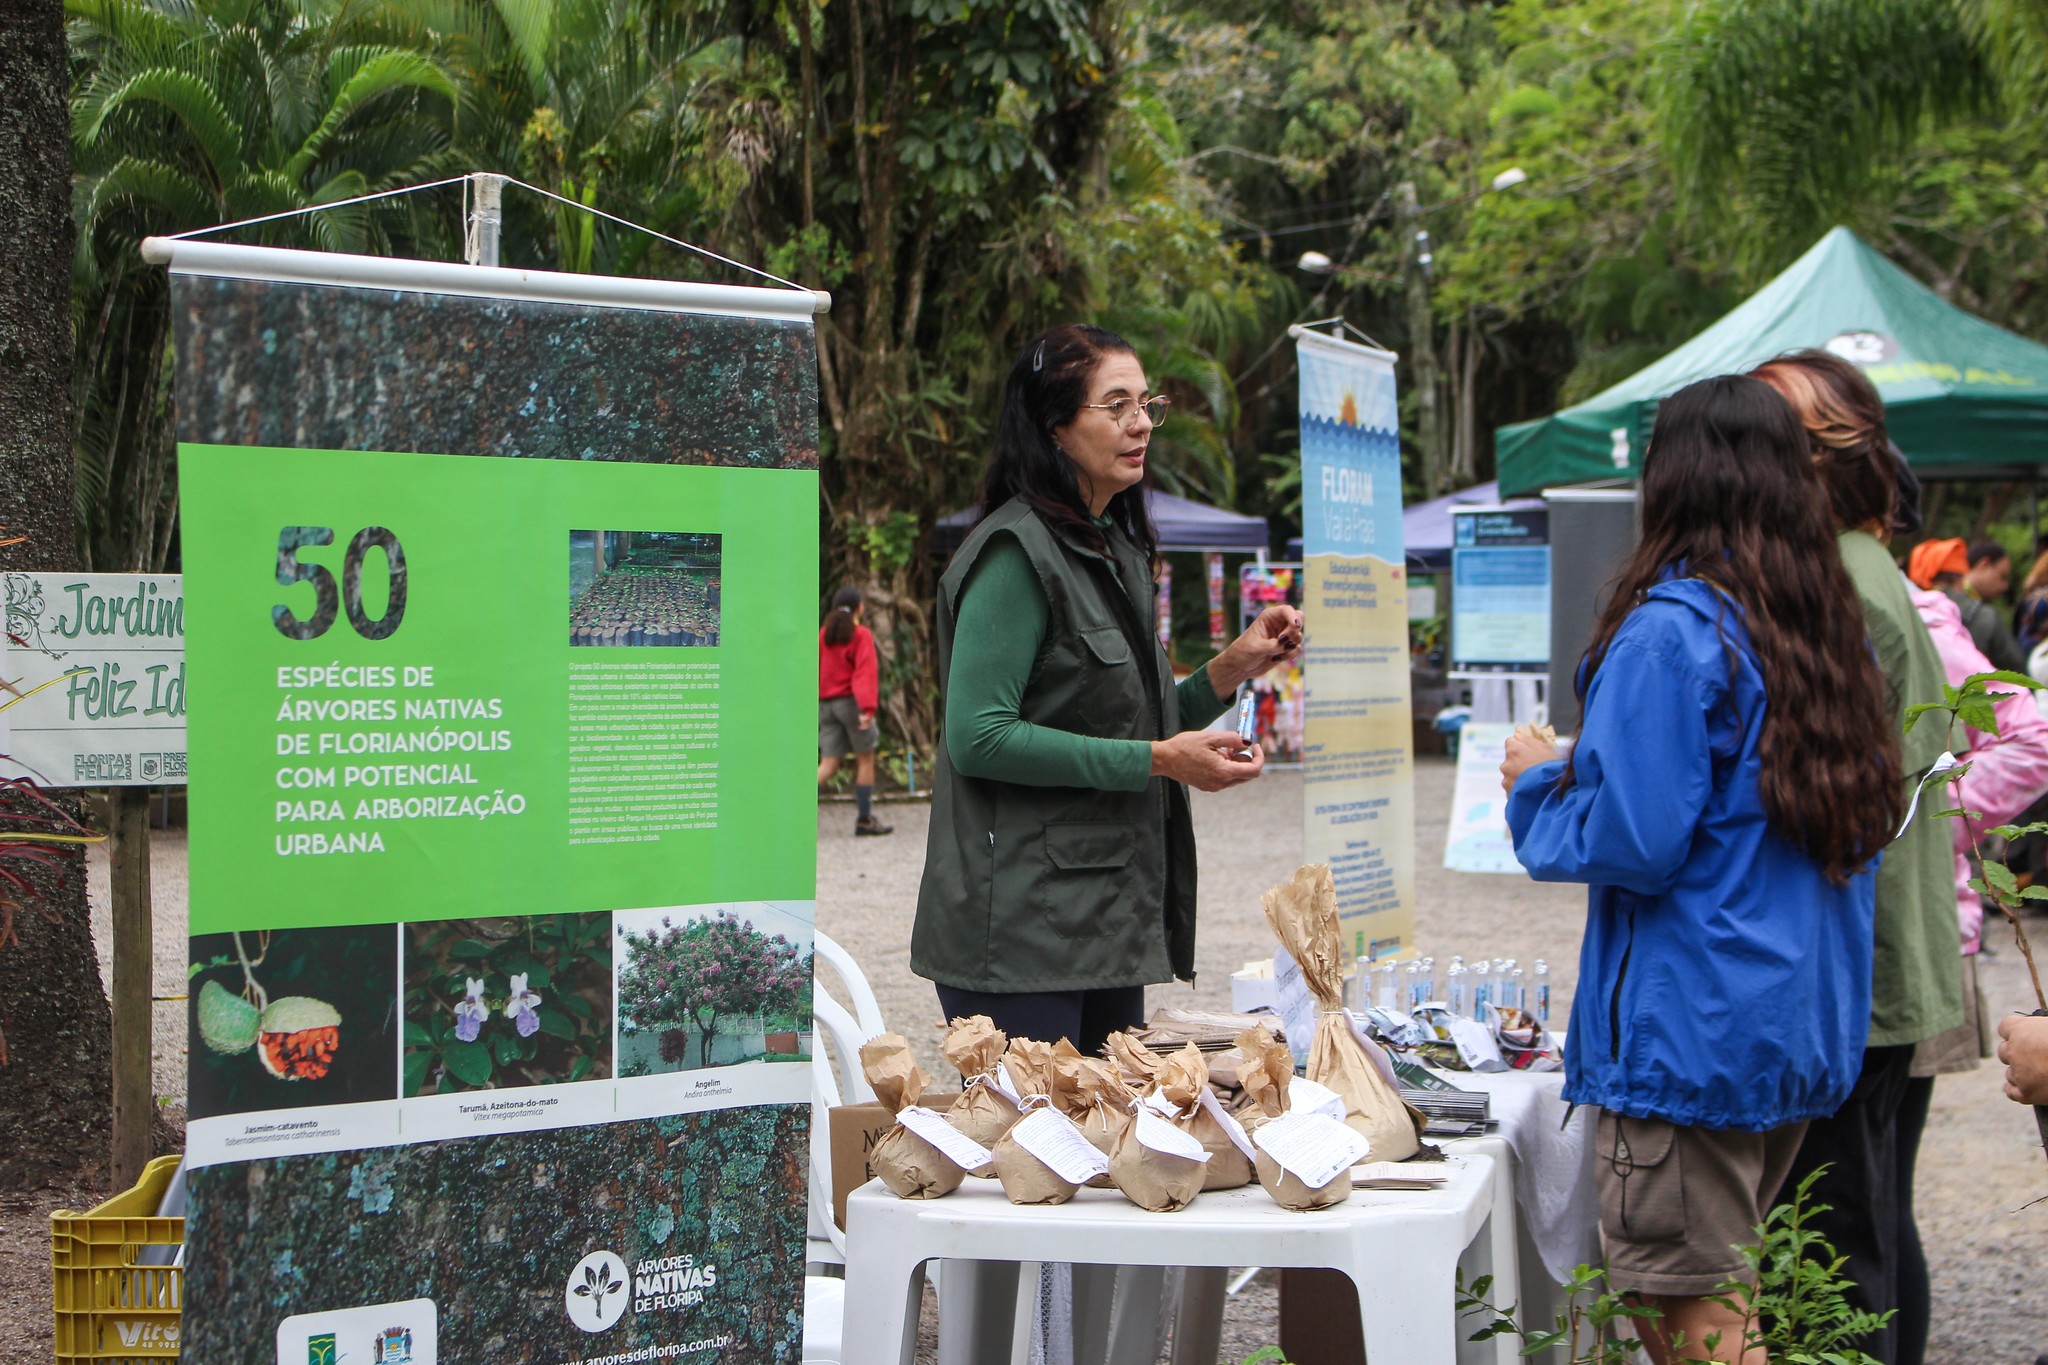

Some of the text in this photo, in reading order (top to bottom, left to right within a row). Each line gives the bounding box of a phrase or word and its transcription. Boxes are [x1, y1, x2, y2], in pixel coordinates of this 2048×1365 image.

[271, 526, 408, 640] 50
[59, 581, 184, 639] Jardim
[277, 661, 434, 688] ESPÉCIES DE
[63, 662, 187, 721] Feliz Id
[276, 694, 503, 722] ÁRVORES NATIVAS
[276, 726, 511, 755] DE FLORIANÓPOLIS
[74, 754, 124, 766] FLORIPA
[163, 752, 187, 762] PREF
[163, 761, 187, 771] FLOR
[74, 765, 125, 781] FELIZ
[276, 764, 478, 789] COM POTENCIAL
[276, 789, 526, 822] PARA ARBORIZAÇÃO
[276, 832, 385, 856] URBANA
[695, 1079, 720, 1089] Angelim
[490, 1098, 558, 1110] Azeitona-do-mato
[244, 1120, 318, 1134] Jasmim-catavento
[636, 1254, 692, 1275] ÁRVORES
[636, 1265, 716, 1298] NATIVAS
[635, 1290, 703, 1313] DE FLORIPA
